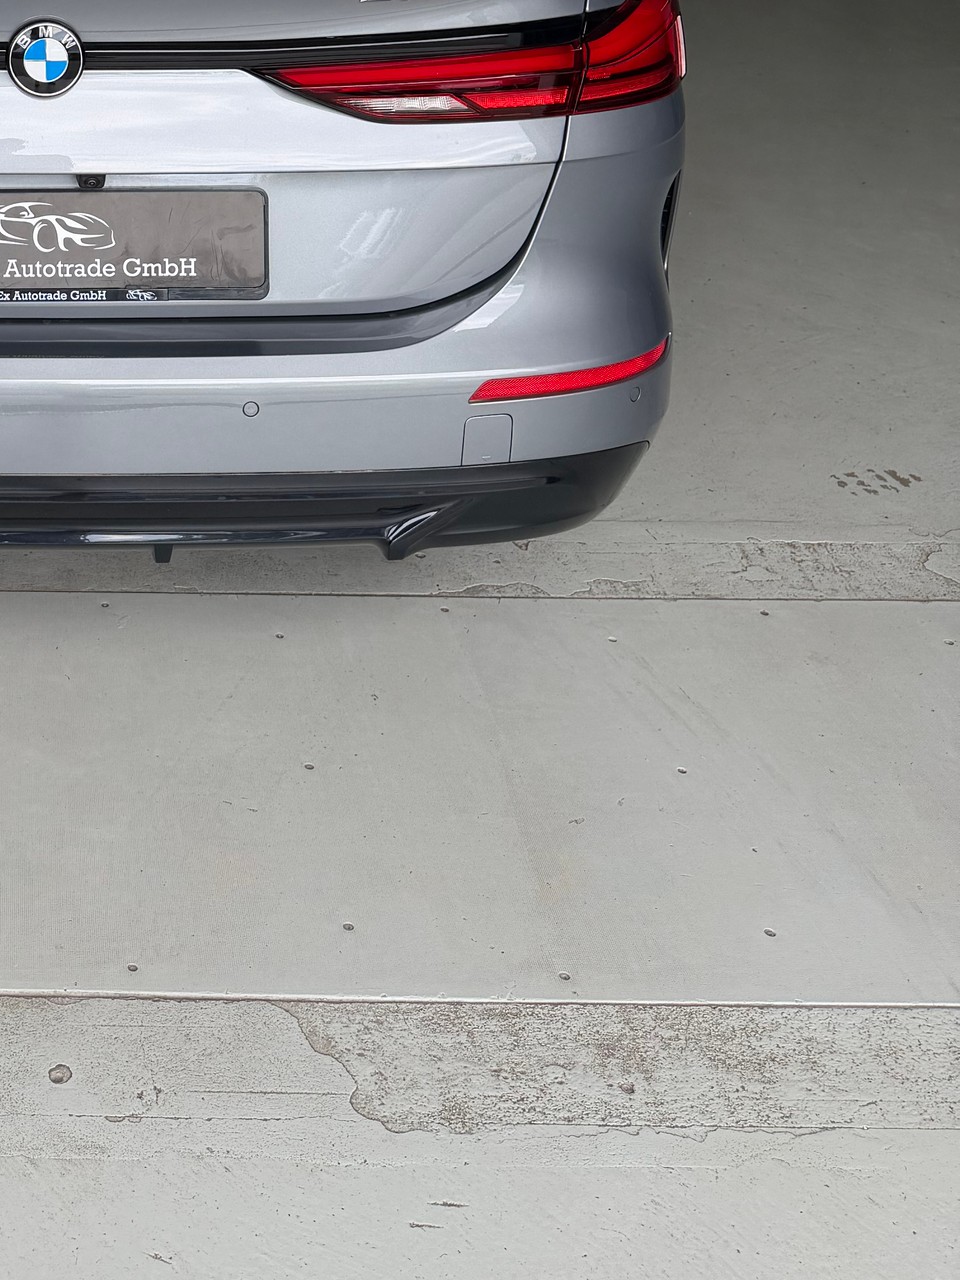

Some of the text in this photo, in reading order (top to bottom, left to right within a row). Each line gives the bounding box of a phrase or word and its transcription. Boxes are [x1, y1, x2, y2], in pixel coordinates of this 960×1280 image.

[16, 26, 76, 50] BMW
[3, 259, 116, 279] Autotrade
[122, 258, 197, 278] GmbH
[13, 290, 67, 301] Autotrade
[70, 290, 107, 301] GmbH
